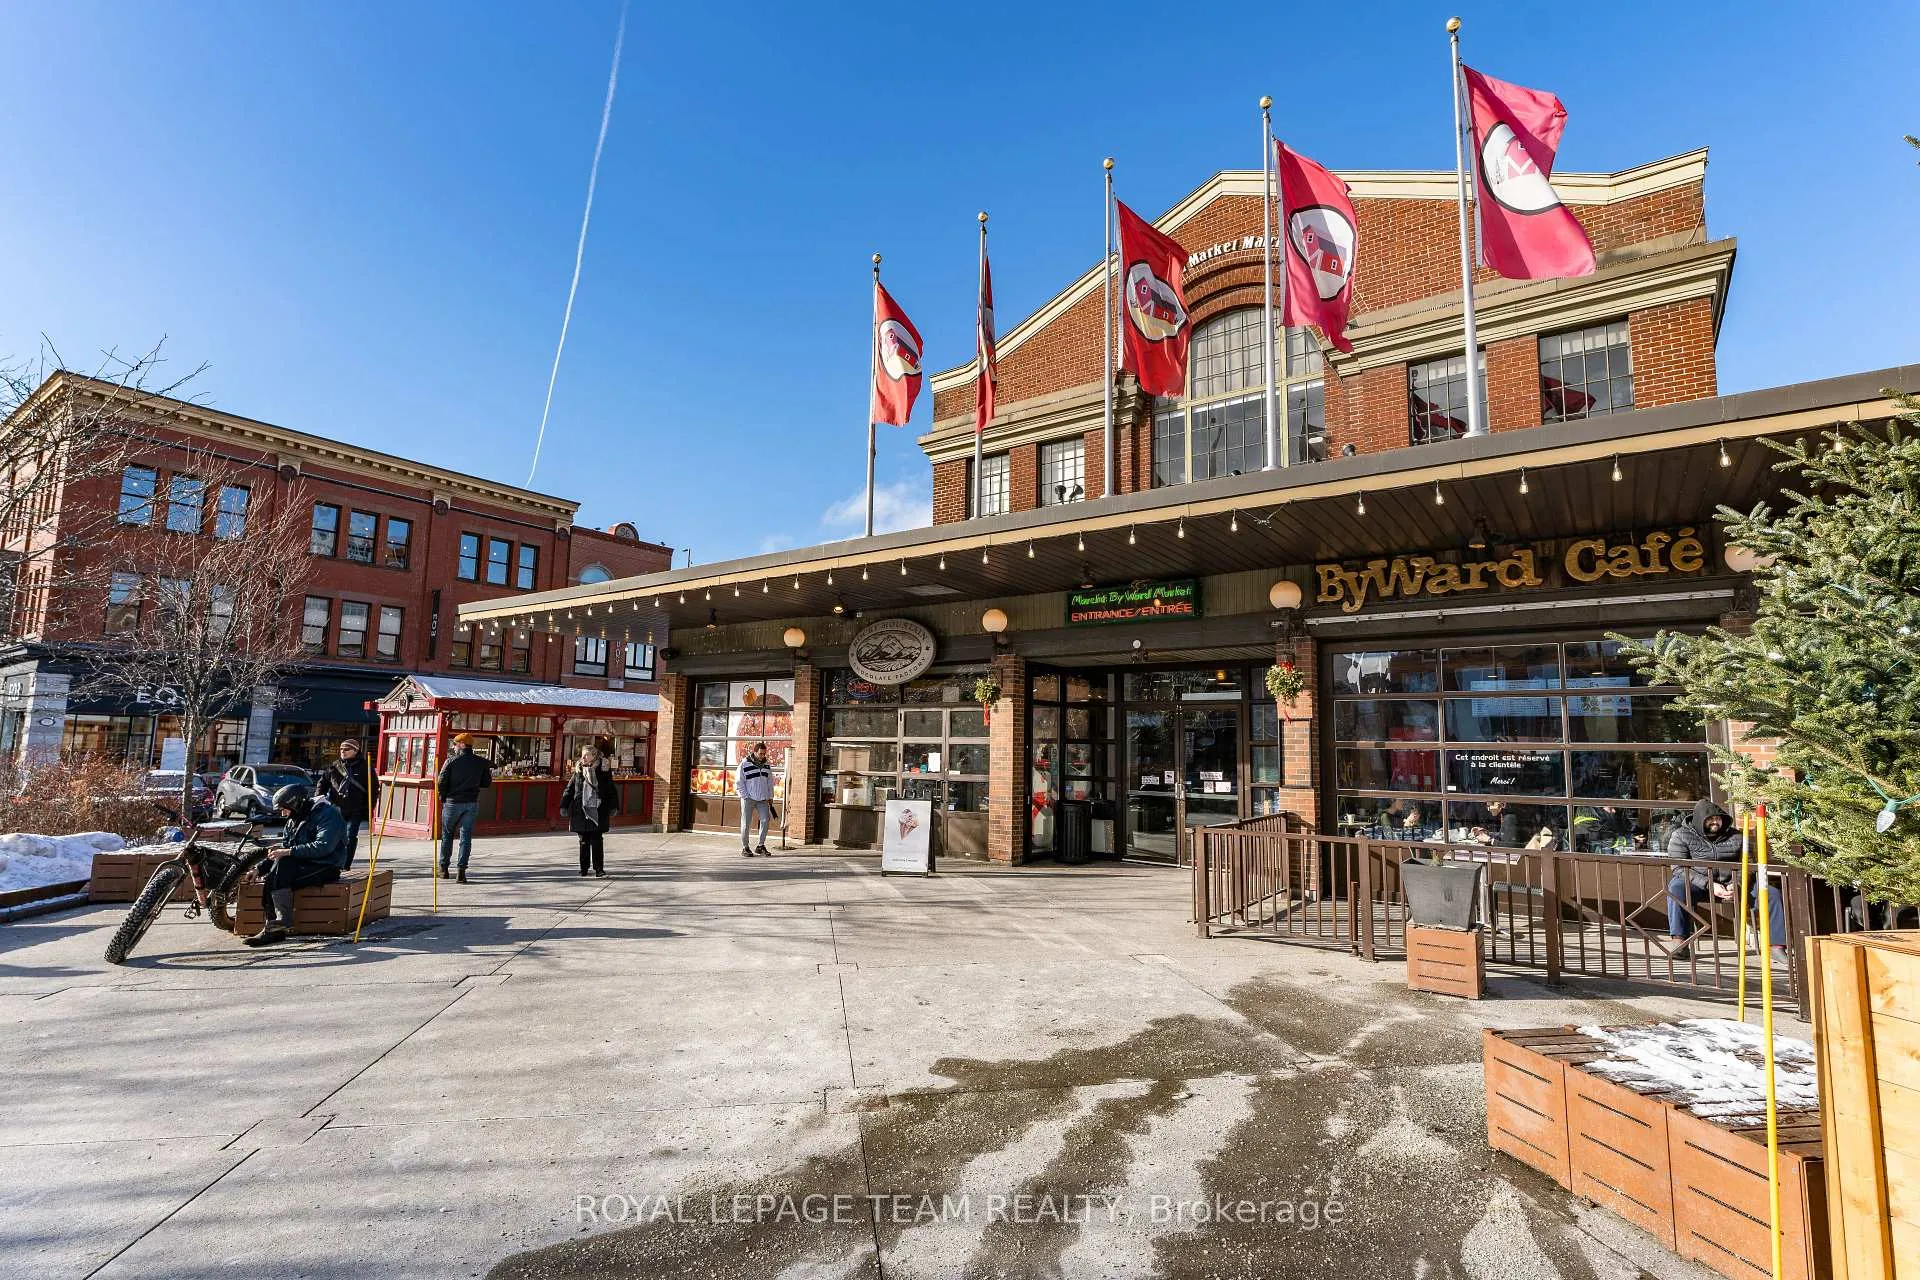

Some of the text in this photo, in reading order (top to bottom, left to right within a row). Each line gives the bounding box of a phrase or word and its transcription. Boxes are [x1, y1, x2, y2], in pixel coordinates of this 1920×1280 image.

[1188, 239, 1238, 267] Market
[1315, 527, 1704, 613] ByWard Café
[1109, 591, 1124, 604] By
[1153, 585, 1193, 599] Market
[895, 656, 926, 679] FACTORY
[1518, 754, 1550, 762] réservé
